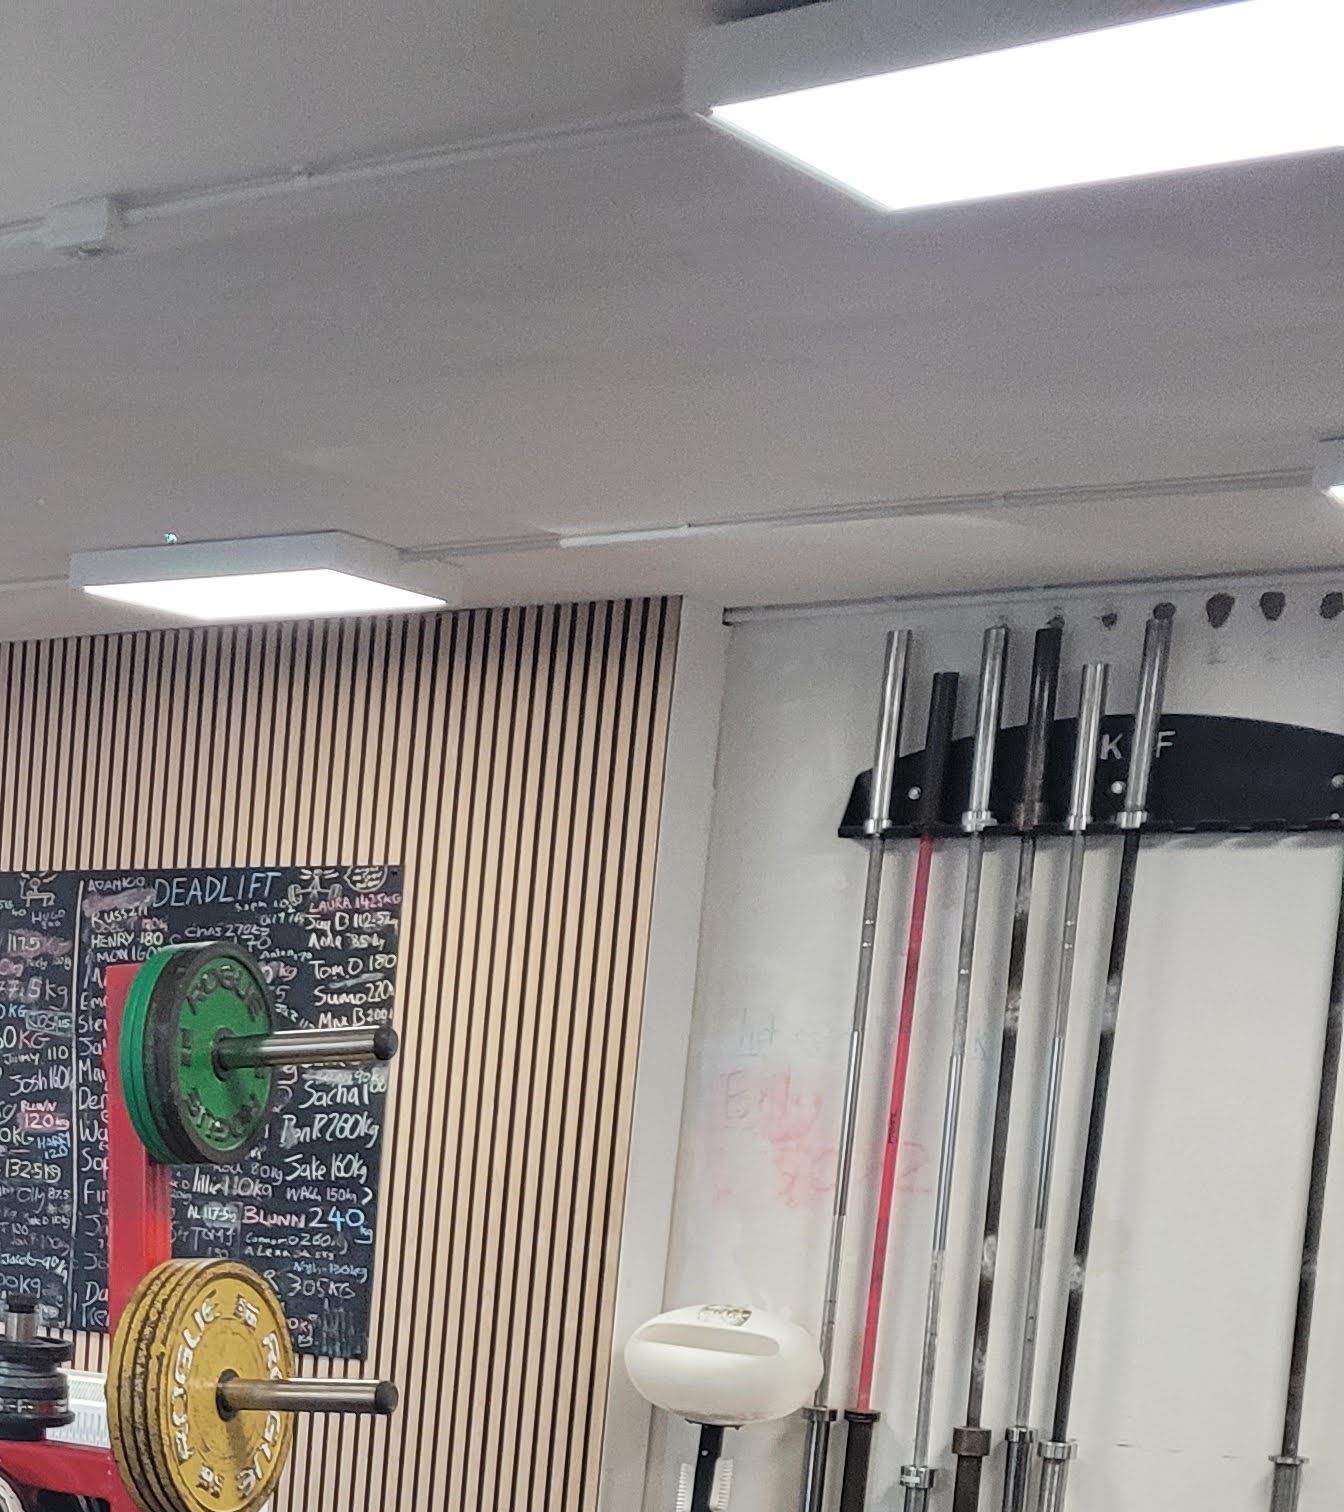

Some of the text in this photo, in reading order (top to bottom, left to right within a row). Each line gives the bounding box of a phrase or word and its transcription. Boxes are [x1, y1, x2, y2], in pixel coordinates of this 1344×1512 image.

[151, 871, 282, 908] DEADLIFT
[91, 931, 134, 948] HENRY
[242, 1205, 306, 1224] BLUNN
[308, 1208, 365, 1232] 240
